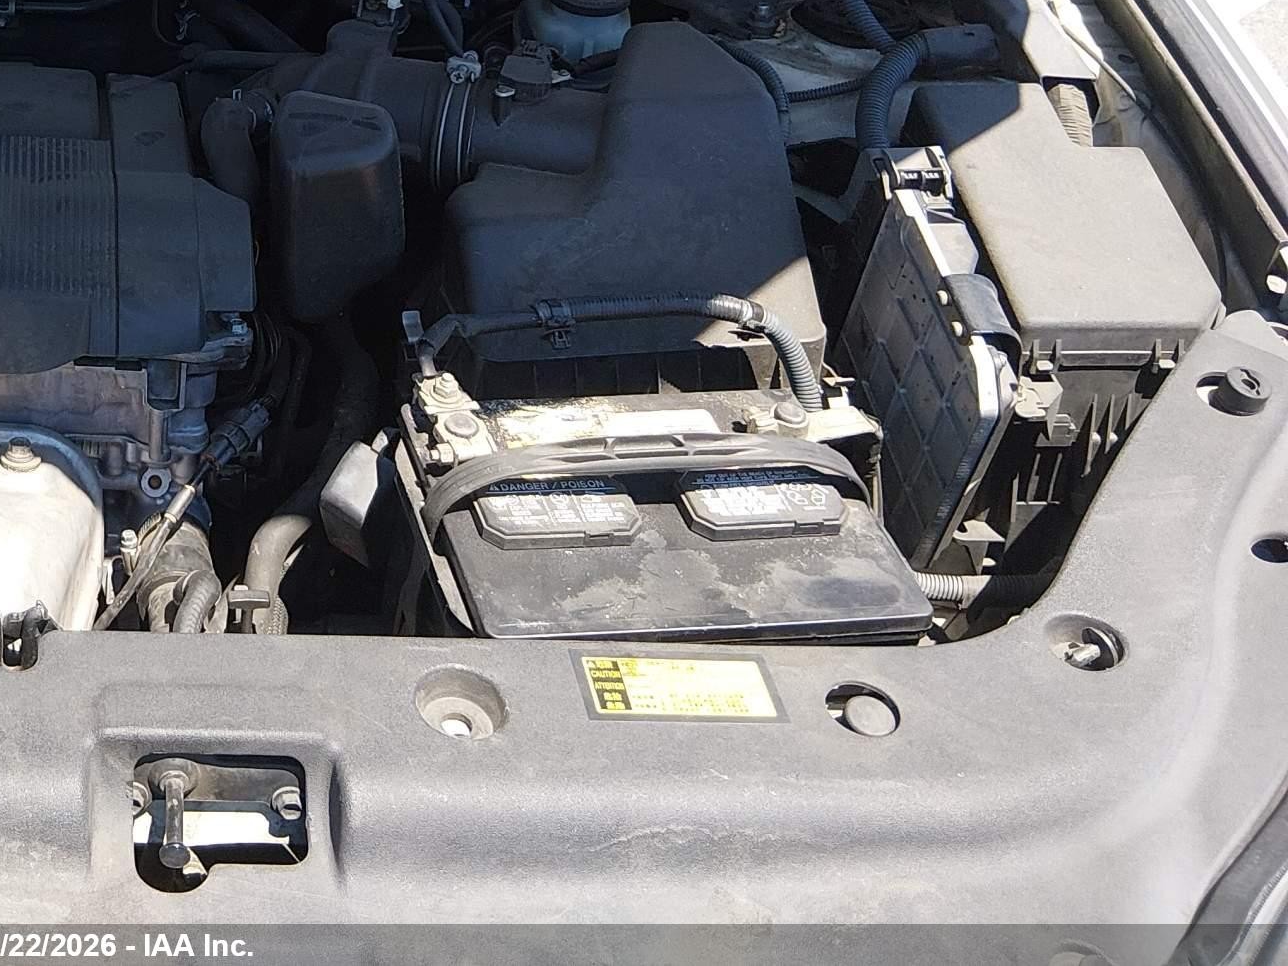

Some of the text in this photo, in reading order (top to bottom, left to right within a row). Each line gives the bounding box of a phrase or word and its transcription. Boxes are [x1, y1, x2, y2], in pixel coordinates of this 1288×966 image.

[500, 482, 549, 492] DANGER
[562, 479, 605, 489] POISON
[590, 670, 622, 679] CAUTION
